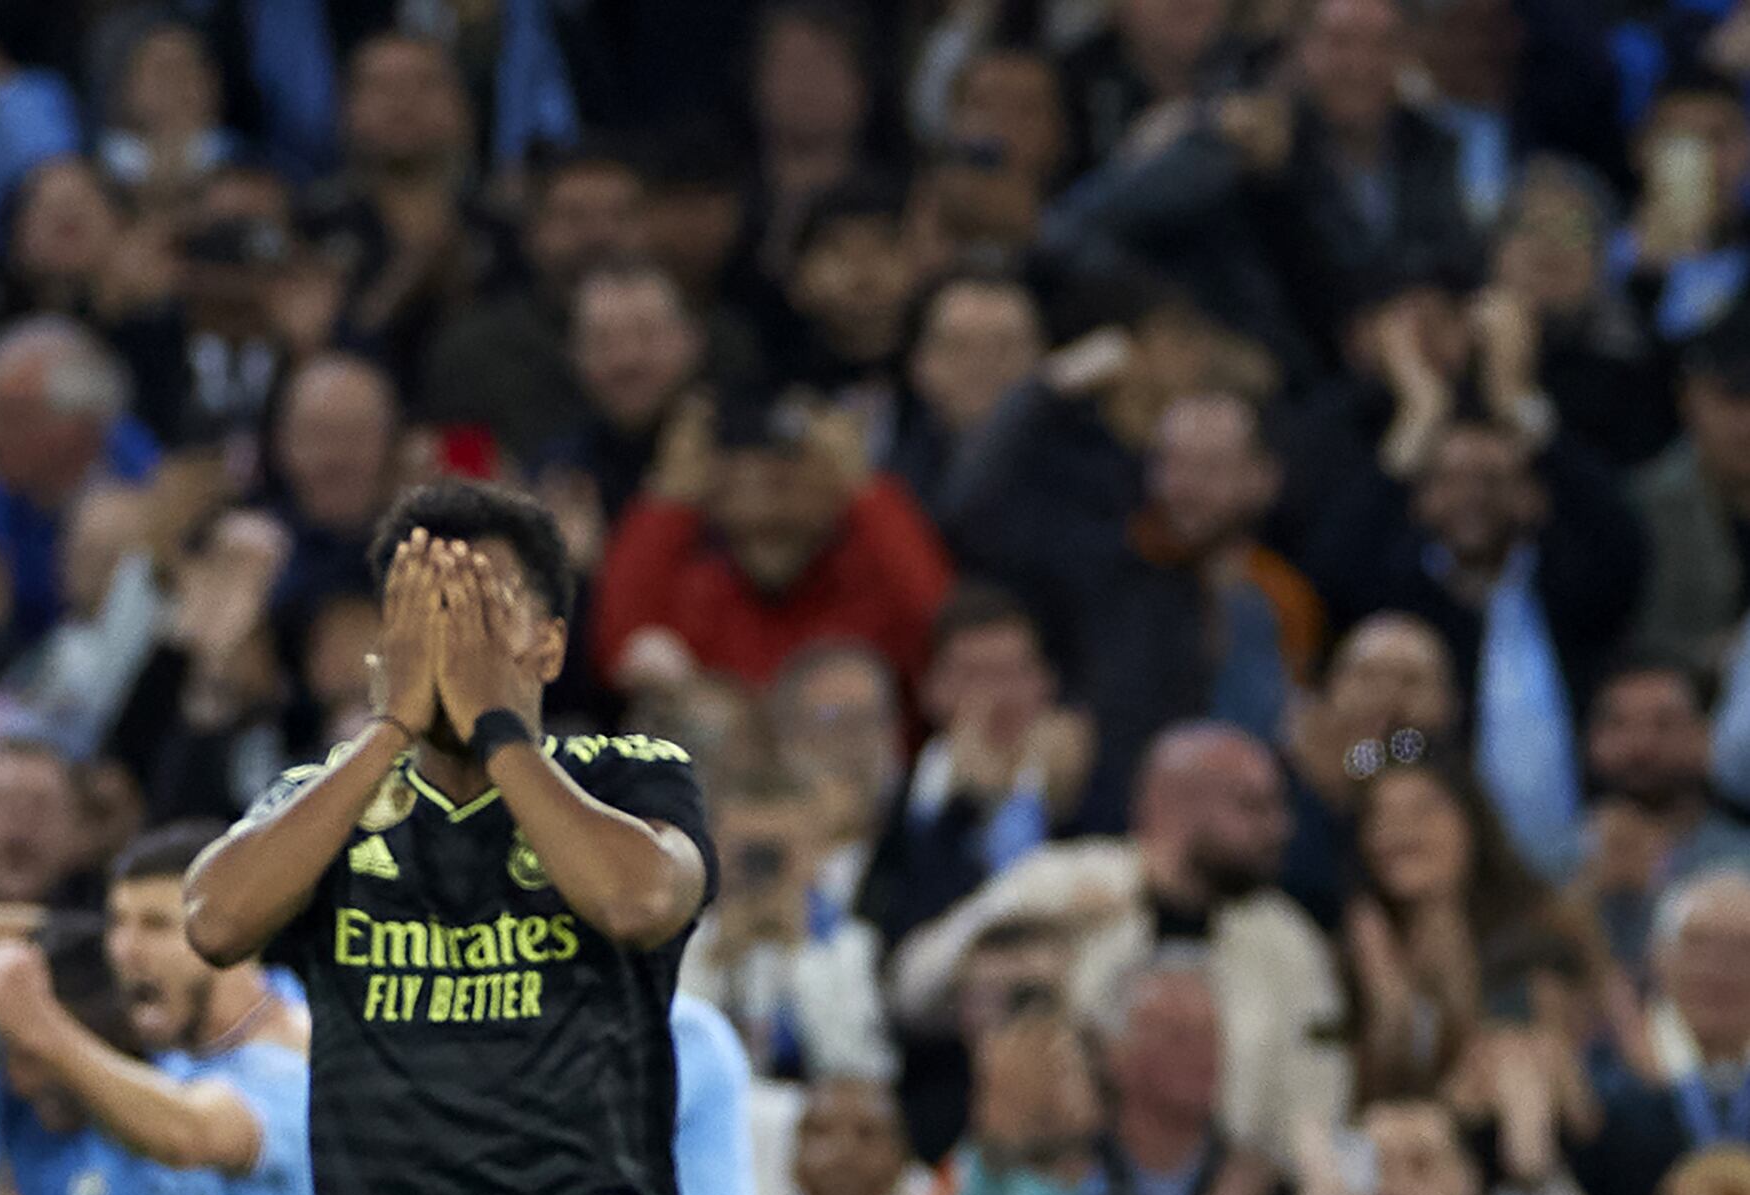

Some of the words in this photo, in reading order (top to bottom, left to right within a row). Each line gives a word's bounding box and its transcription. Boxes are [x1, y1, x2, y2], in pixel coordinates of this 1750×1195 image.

[334, 907, 580, 969] Emirates
[363, 973, 424, 1022] FLY
[427, 969, 543, 1023] BETTER
